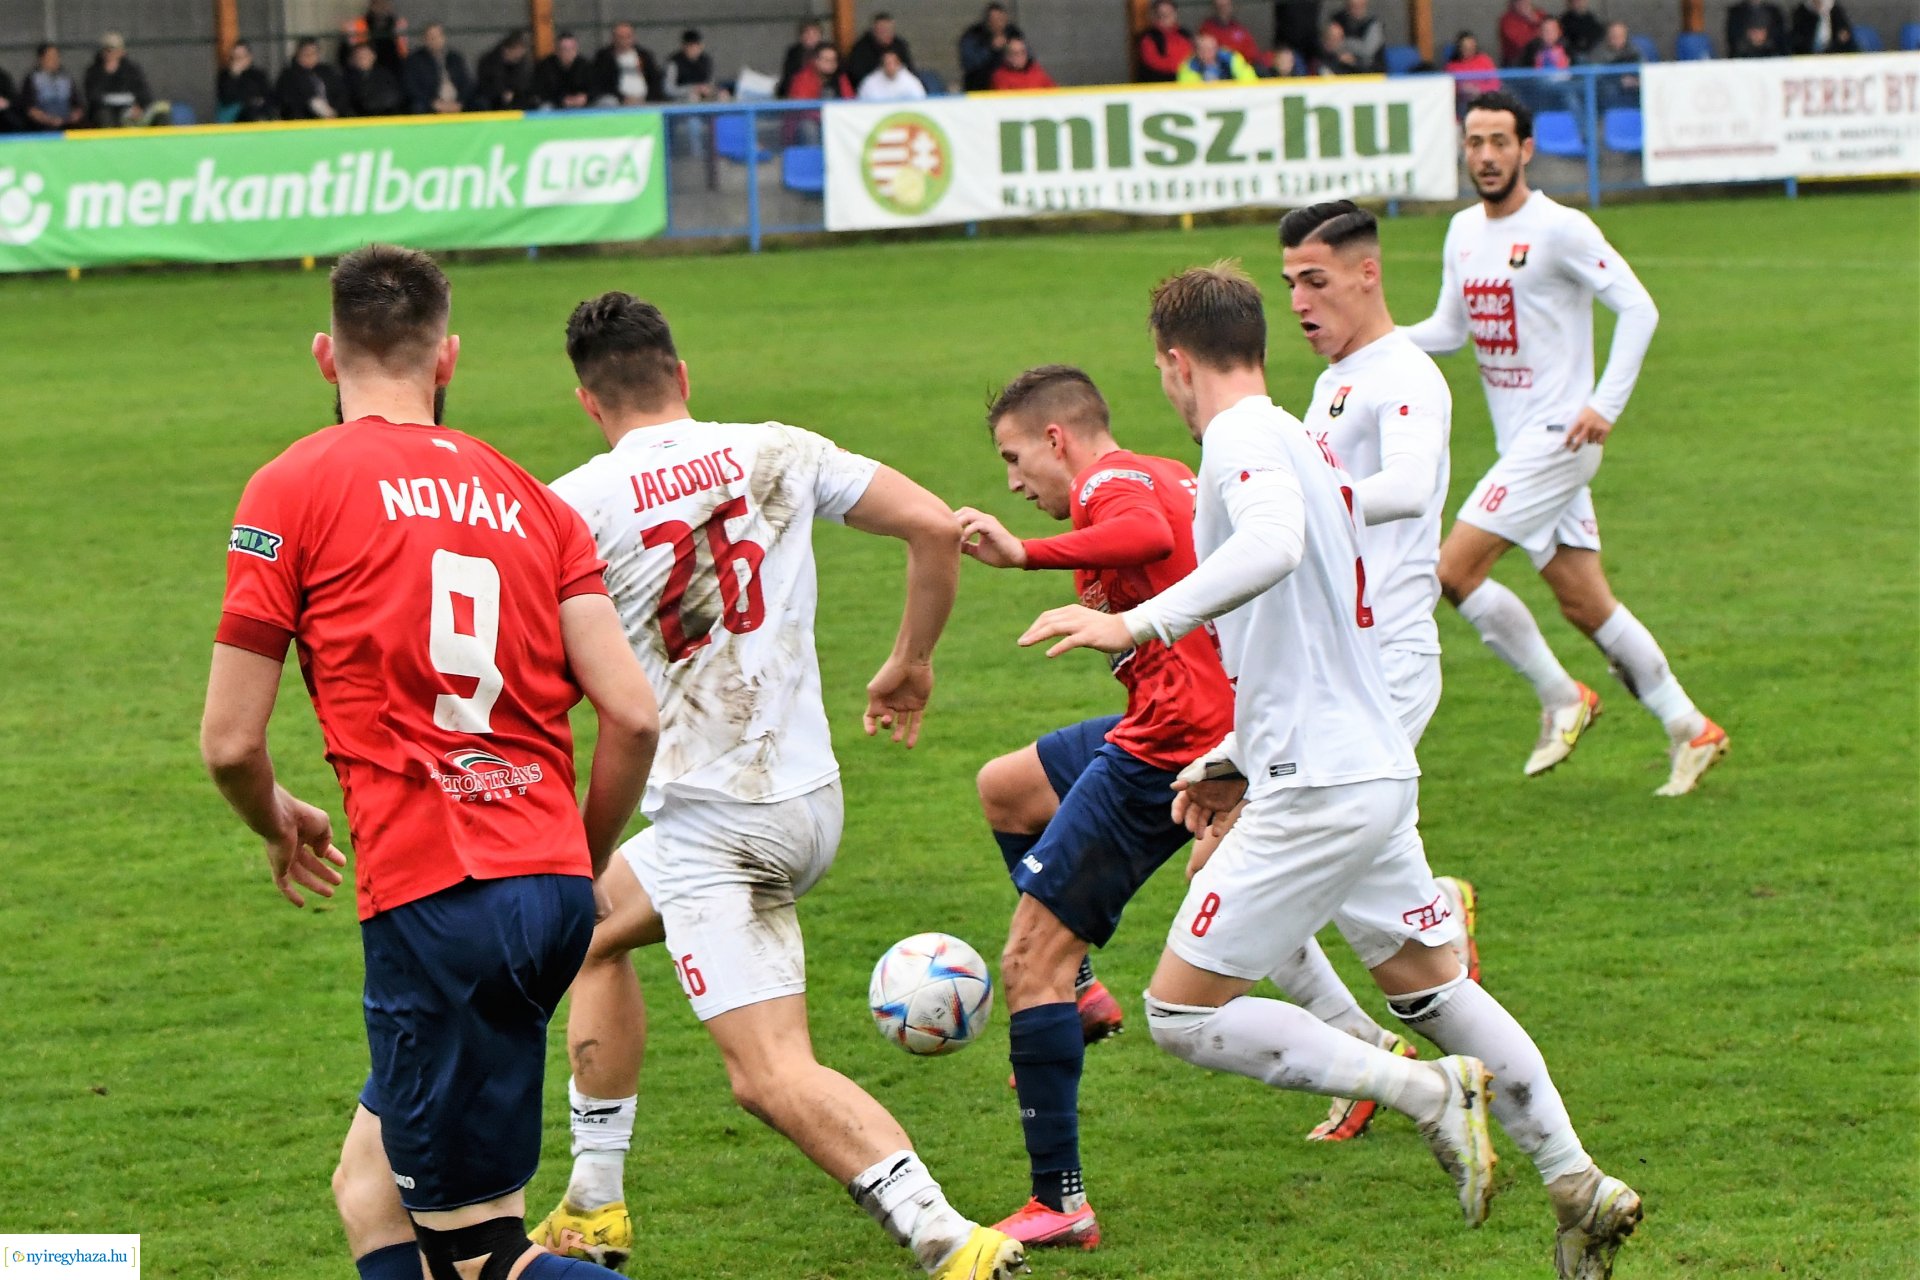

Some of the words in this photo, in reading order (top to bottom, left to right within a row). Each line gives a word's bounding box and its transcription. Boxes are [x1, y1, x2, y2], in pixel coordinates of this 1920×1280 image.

[999, 95, 1411, 174] mlsz.hu
[65, 145, 519, 229] merkantilbank
[538, 150, 641, 193] LIGA
[378, 476, 527, 539] NOVÁK
[630, 447, 745, 513] JAGODICS
[1479, 483, 1508, 512] 18
[640, 495, 766, 663] 26
[429, 548, 504, 734] 9
[1191, 892, 1220, 937] 8
